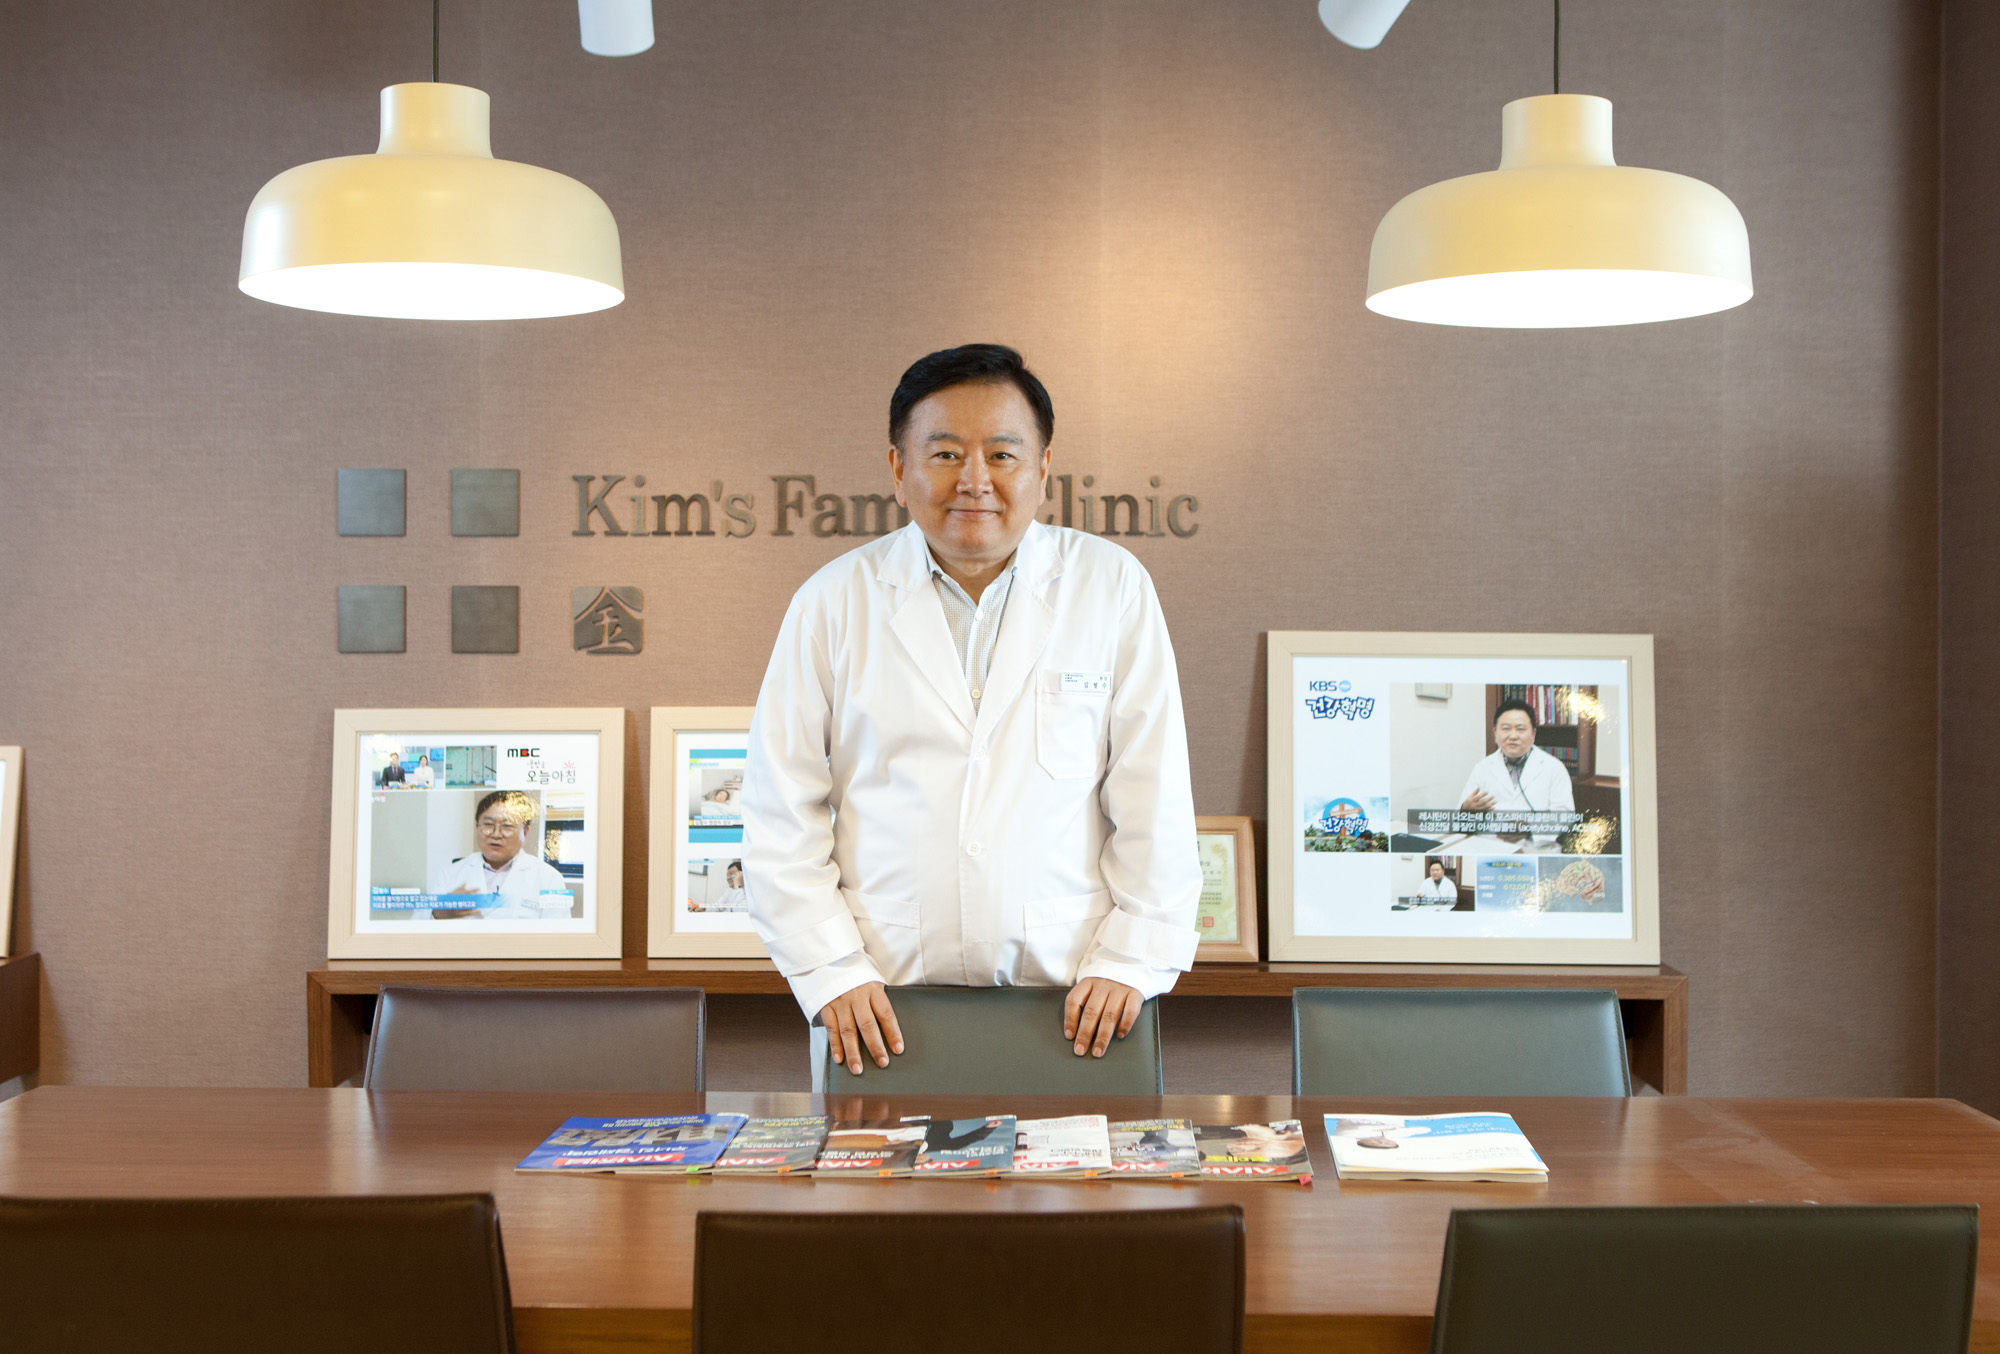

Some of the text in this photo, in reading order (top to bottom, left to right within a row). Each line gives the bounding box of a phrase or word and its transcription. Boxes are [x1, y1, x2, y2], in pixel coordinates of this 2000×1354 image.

[571, 474, 756, 538] Kim's
[770, 474, 909, 537] Fam
[1309, 680, 1337, 692] KBS
[1305, 695, 1375, 721] 건강혁명
[507, 748, 540, 758] MBC
[1451, 811, 1484, 821] 나오는데
[1485, 812, 1494, 821] 이
[1319, 816, 1369, 835] 건강혁명
[1418, 821, 1450, 832] 신경전달
